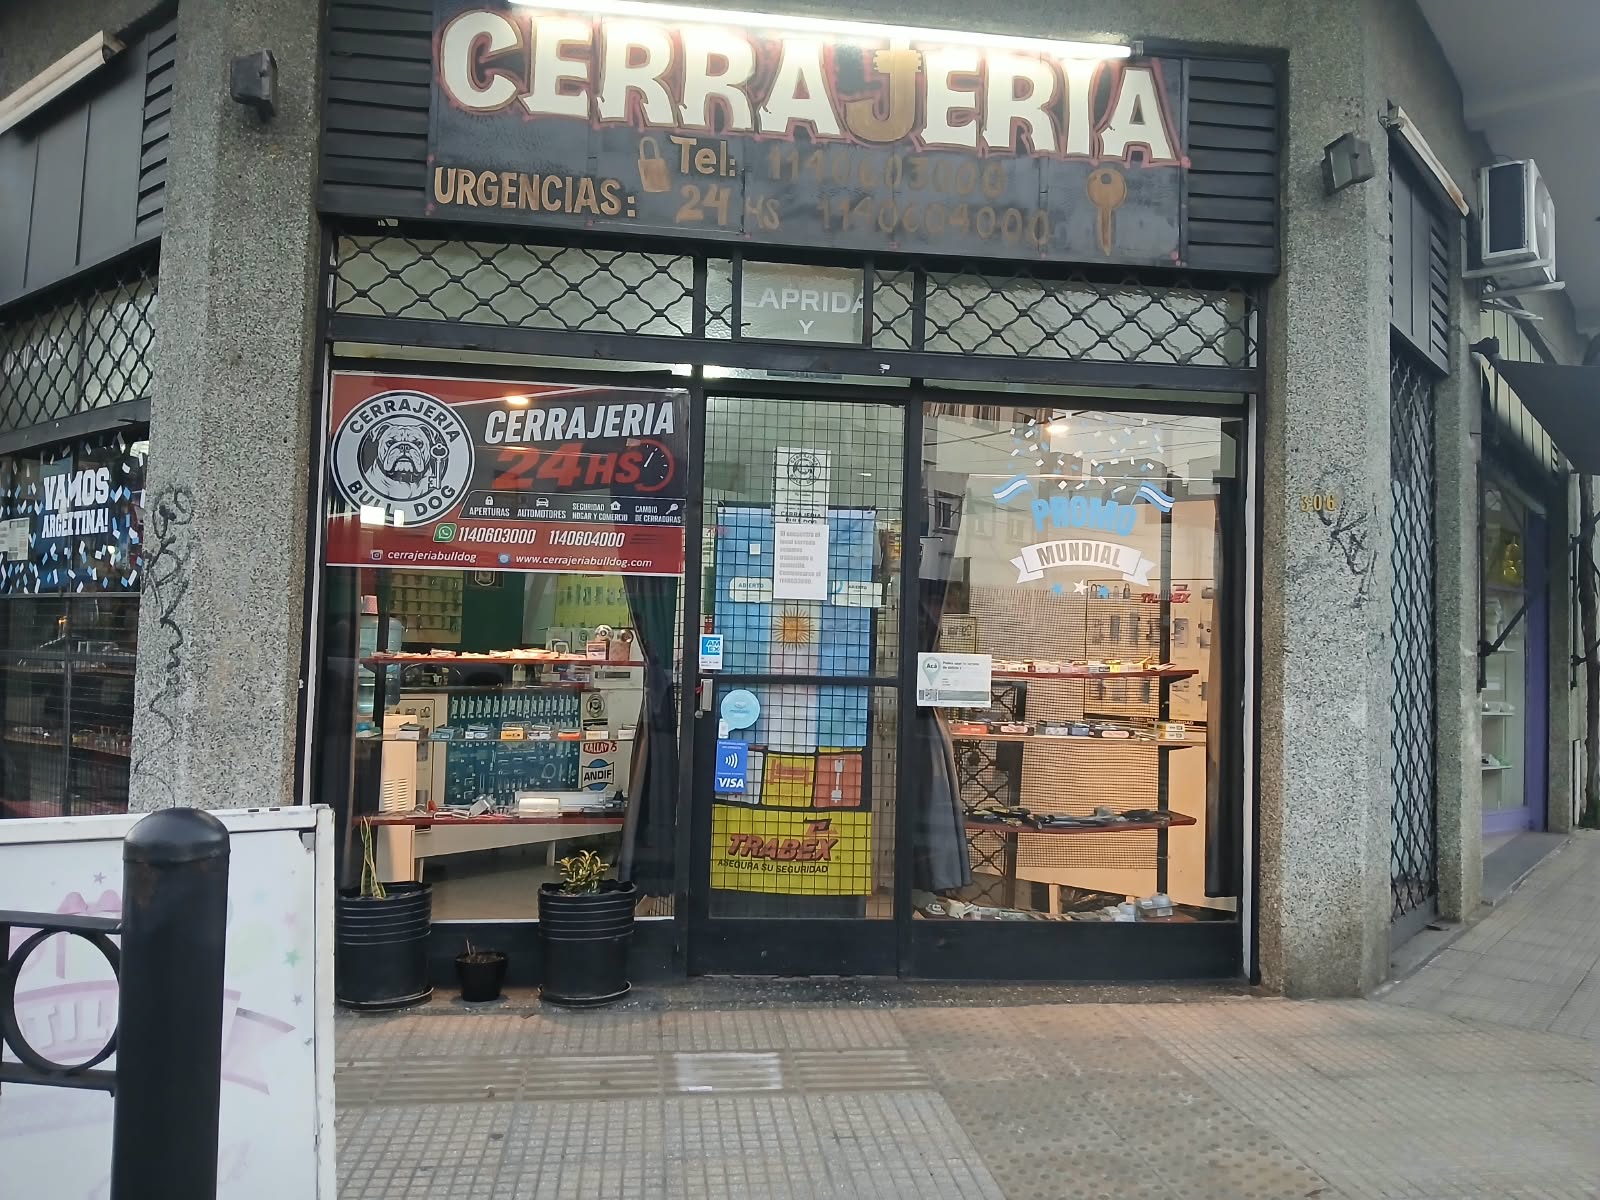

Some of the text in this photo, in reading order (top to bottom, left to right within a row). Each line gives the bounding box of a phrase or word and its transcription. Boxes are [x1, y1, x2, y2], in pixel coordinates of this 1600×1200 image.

[438, 8, 1183, 163] CERRAJERIA
[670, 134, 1009, 198] Tel: 1140603000
[434, 166, 637, 217] URGENCIAS:
[675, 183, 732, 226] 24
[817, 195, 1049, 246] 1140604000
[799, 320, 814, 335] Y
[350, 399, 461, 443] CERRAJERIA
[484, 402, 674, 444] CERRAJERIA
[44, 467, 110, 511] VAMOS
[413, 485, 456, 518] DOG
[572, 502, 605, 511] SEGURIDAD
[635, 505, 658, 514] CAMBIO
[469, 507, 510, 518] APERTURAS
[517, 509, 567, 520] AUTOMOTORES
[572, 511, 593, 520] HOGAR
[599, 512, 628, 521] COMERCIO
[635, 514, 682, 524] DE CERRADURAS
[1031, 495, 1137, 537] PROMO
[459, 526, 625, 548] 1140603000 1140604000
[387, 550, 477, 563] cerrajeriabulldog
[516, 554, 652, 568] www.cerrajeriabulldog.com
[1036, 542, 1121, 568] MUNDIAL
[583, 769, 612, 782] ANDIF
[718, 777, 745, 789] VISA
[727, 834, 839, 862] TRABEX
[717, 858, 828, 874] ASEGURA SU SEGURIDAD
